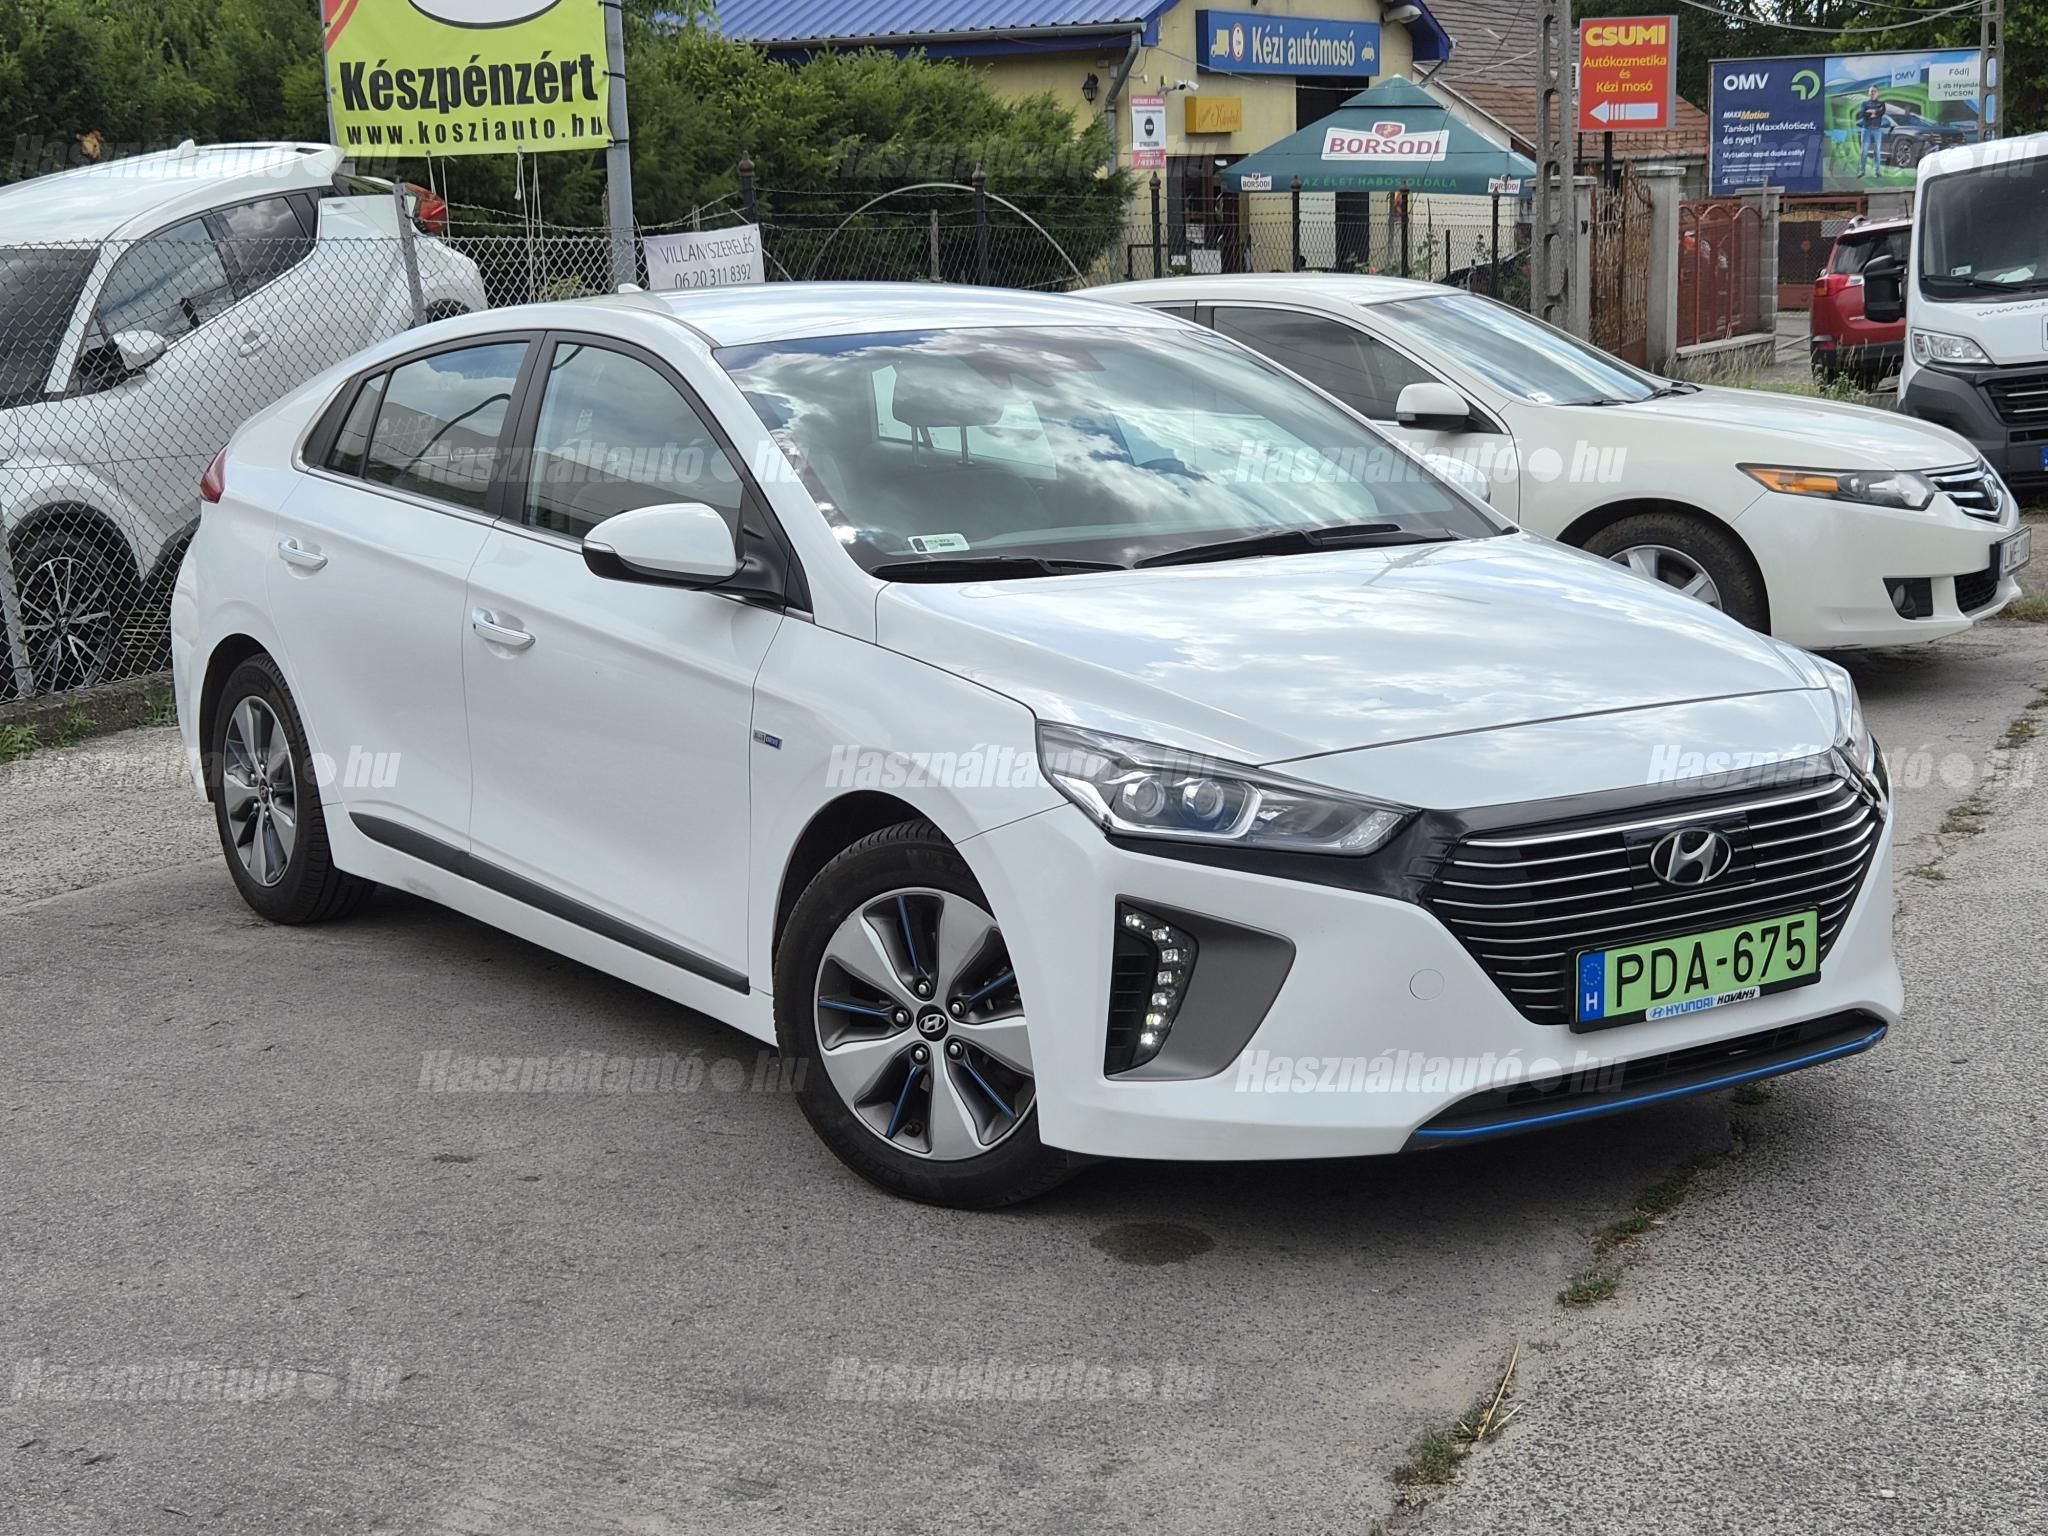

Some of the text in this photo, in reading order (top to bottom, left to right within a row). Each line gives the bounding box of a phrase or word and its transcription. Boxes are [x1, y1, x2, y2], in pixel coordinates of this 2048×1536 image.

[1585, 25, 1667, 47] CSUMI
[1252, 24, 1355, 67] Kézi autómosó
[1583, 55, 1667, 68] Autókozmetika
[339, 50, 598, 114] Készpénzért
[1619, 69, 1631, 79] és
[1723, 73, 1769, 91] OMV
[1895, 70, 1916, 81] OMV
[1596, 80, 1653, 93] Kézi mosó
[1953, 82, 1979, 90] Hyunda
[346, 113, 602, 145] www.kosziauto.hu
[1723, 123, 1754, 134] Tankolj
[1329, 137, 1441, 155] BORSODI
[1723, 134, 1734, 145] és
[1242, 180, 1270, 189] BORSODI
[1303, 175, 1457, 188] AZ ÉLET HABOS OLDALA
[674, 263, 751, 289] 06 20 311 8392
[1616, 920, 1806, 1008] PDA-675
[1585, 991, 1598, 1012] H
[1666, 987, 1756, 1017] HYUNDAI HOVÁNY
